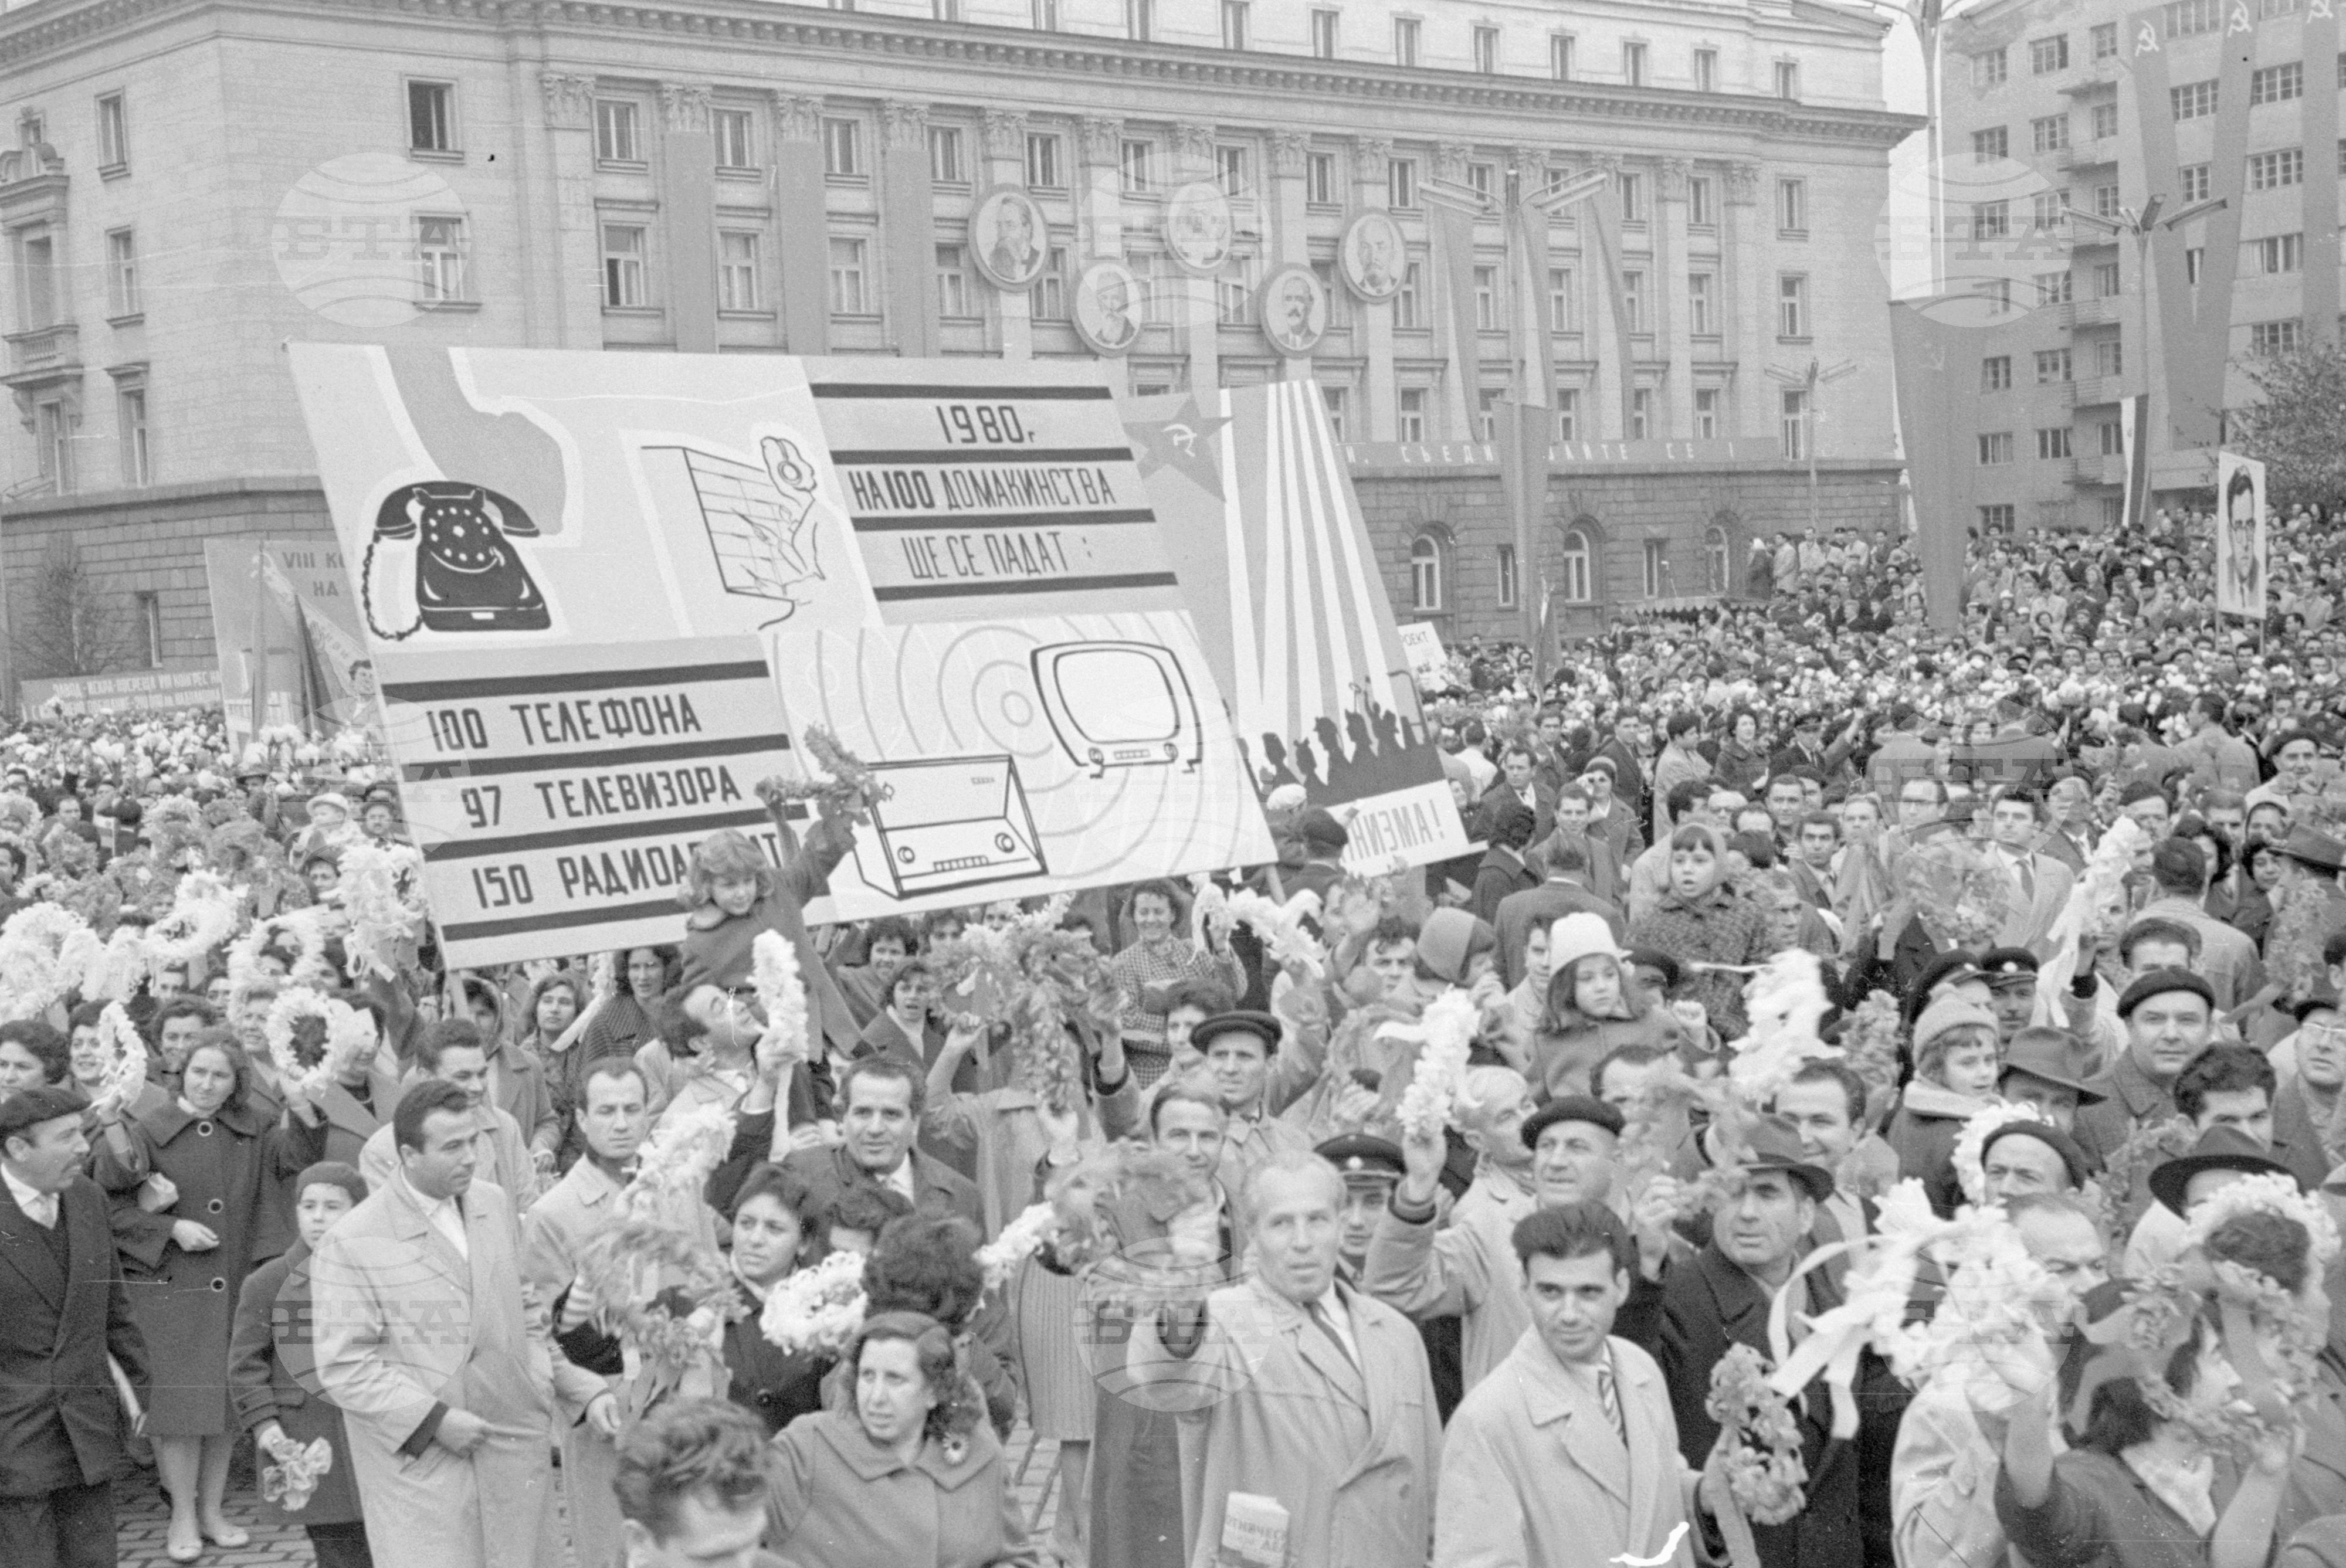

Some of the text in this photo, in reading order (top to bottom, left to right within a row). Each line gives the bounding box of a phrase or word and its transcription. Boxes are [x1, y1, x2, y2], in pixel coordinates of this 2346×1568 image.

[940, 469, 1116, 510] ДОМАКИНСТВА
[282, 552, 315, 568] VIII
[901, 536, 948, 579] ЩЕ
[945, 535, 985, 576] СЕ
[983, 532, 1069, 575] ПАДАТ
[313, 581, 339, 596] НА
[426, 693, 702, 752] 100 ТЕЛЕФОНА
[461, 765, 742, 829] 97 ТЕЛЕВИЗОРА
[472, 864, 534, 909] 150
